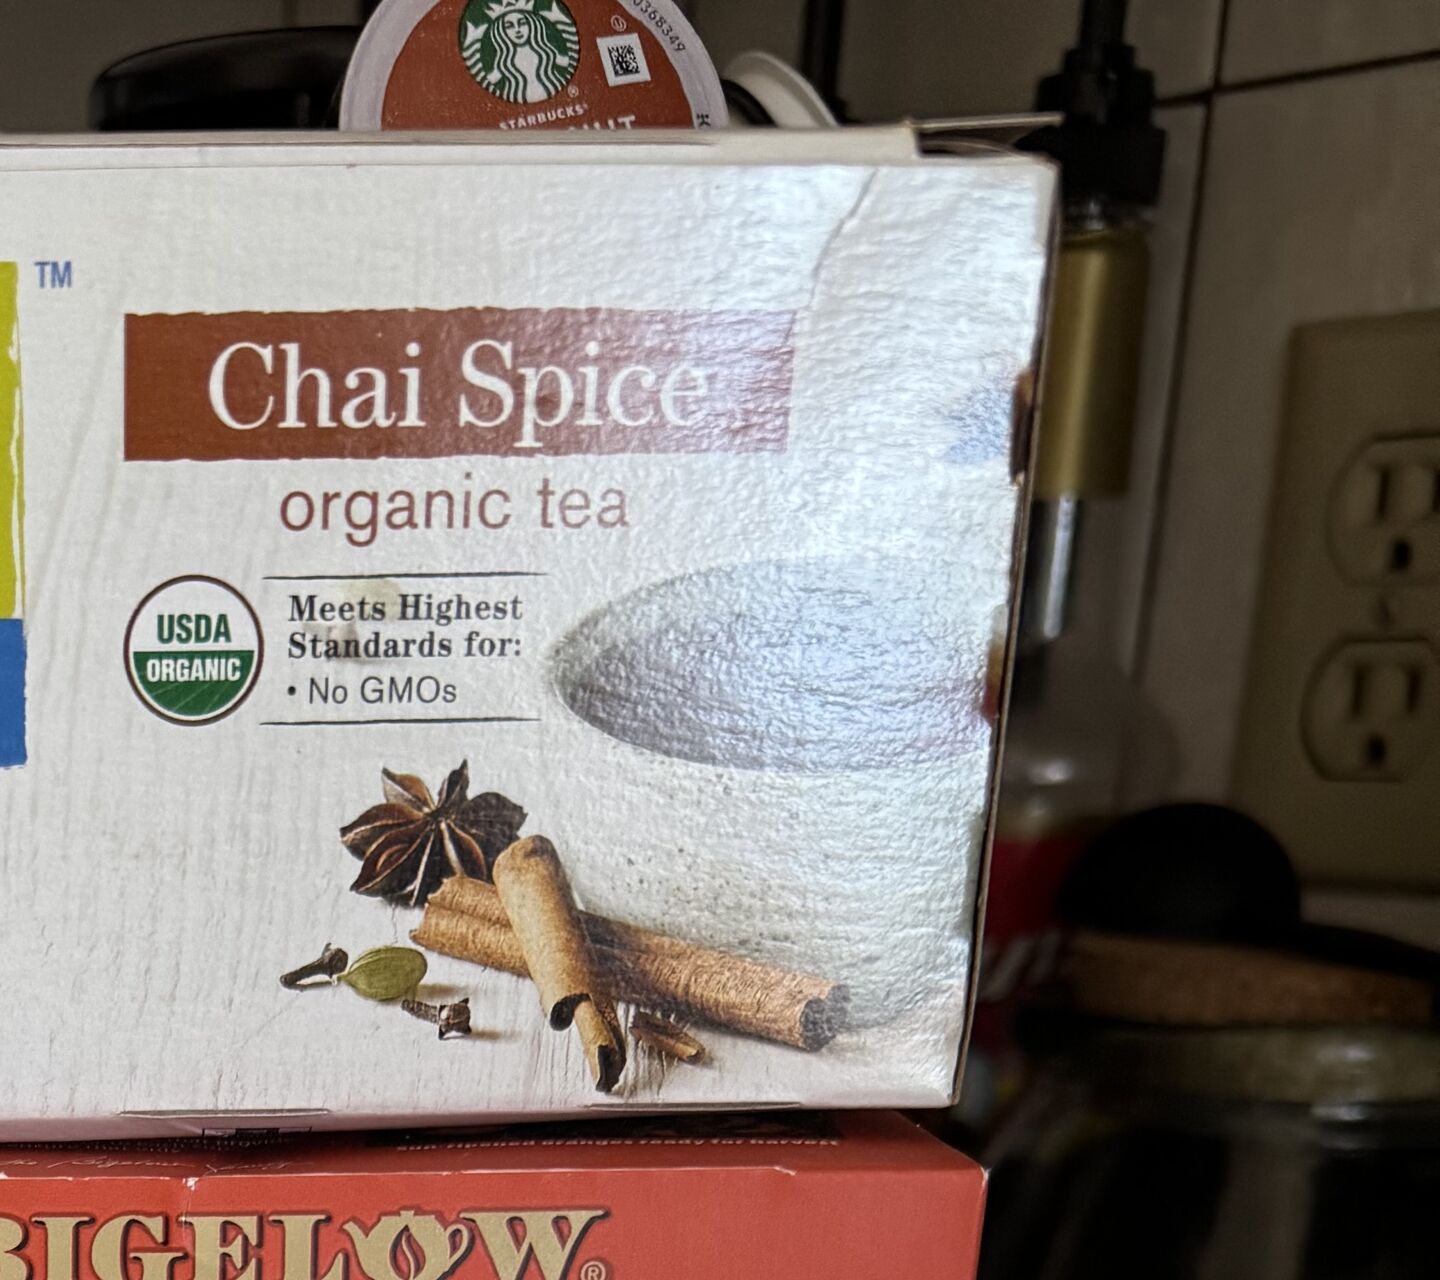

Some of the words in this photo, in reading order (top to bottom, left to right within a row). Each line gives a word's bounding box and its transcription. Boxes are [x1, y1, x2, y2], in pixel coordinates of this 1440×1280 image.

[500, 104, 585, 129] STARBUCKS
[209, 341, 426, 430] Chai
[460, 339, 712, 448] Spice
[280, 471, 512, 549] organic
[537, 477, 631, 530] tea
[287, 595, 389, 623] Meets
[398, 593, 523, 625] Highest
[156, 613, 232, 645] USDA
[287, 630, 454, 661] Standards
[463, 632, 522, 658] for:
[146, 657, 242, 683] ORGANIC
[309, 677, 348, 705] No
[360, 676, 458, 705] GMOs
